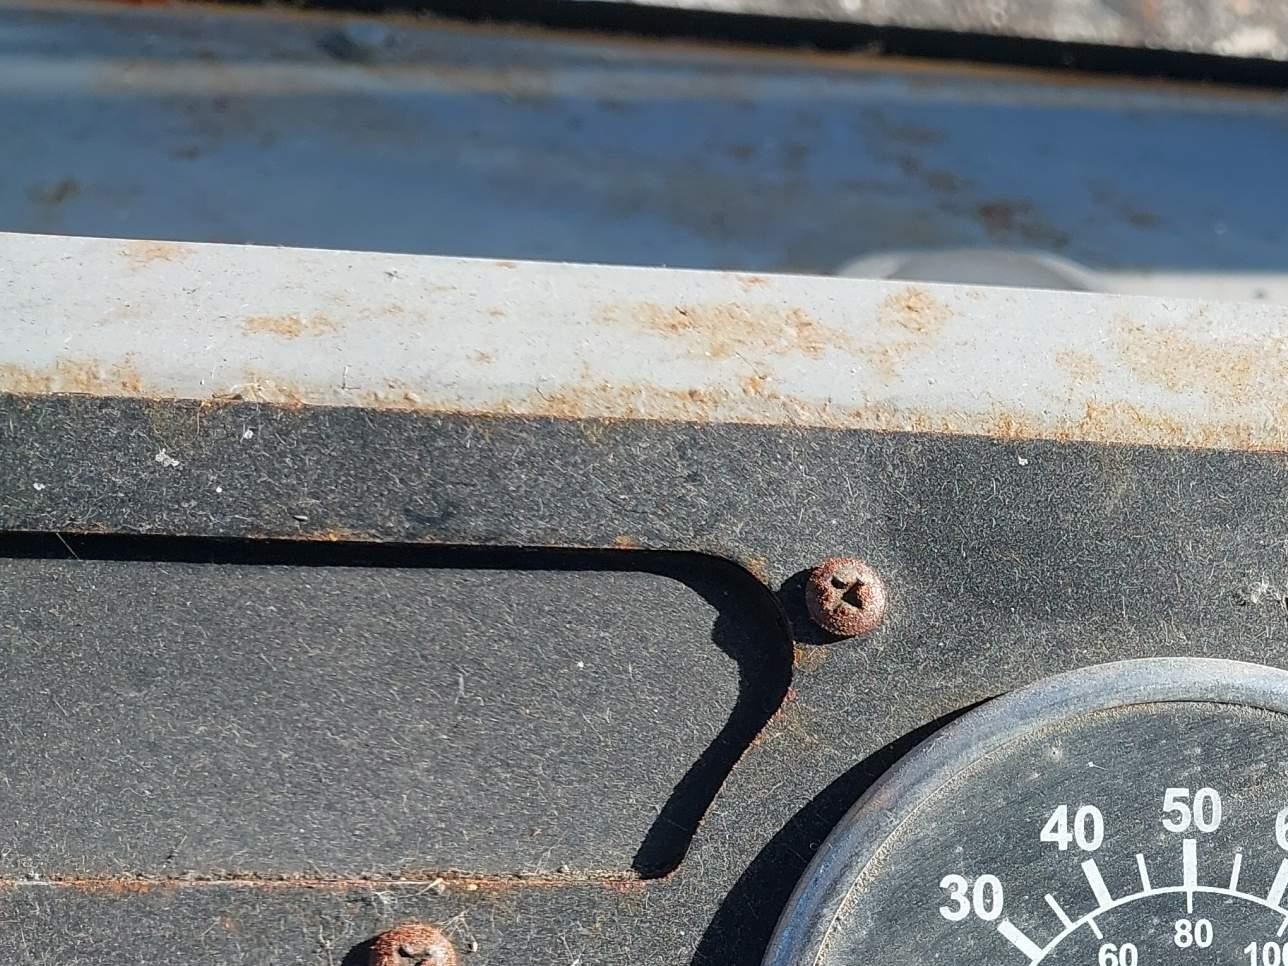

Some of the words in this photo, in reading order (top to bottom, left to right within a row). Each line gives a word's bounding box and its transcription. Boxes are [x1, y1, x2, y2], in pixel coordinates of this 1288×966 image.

[1040, 805, 1104, 851] 40
[1161, 787, 1222, 832] 50
[939, 874, 1003, 920] 30
[1174, 919, 1213, 948] 80
